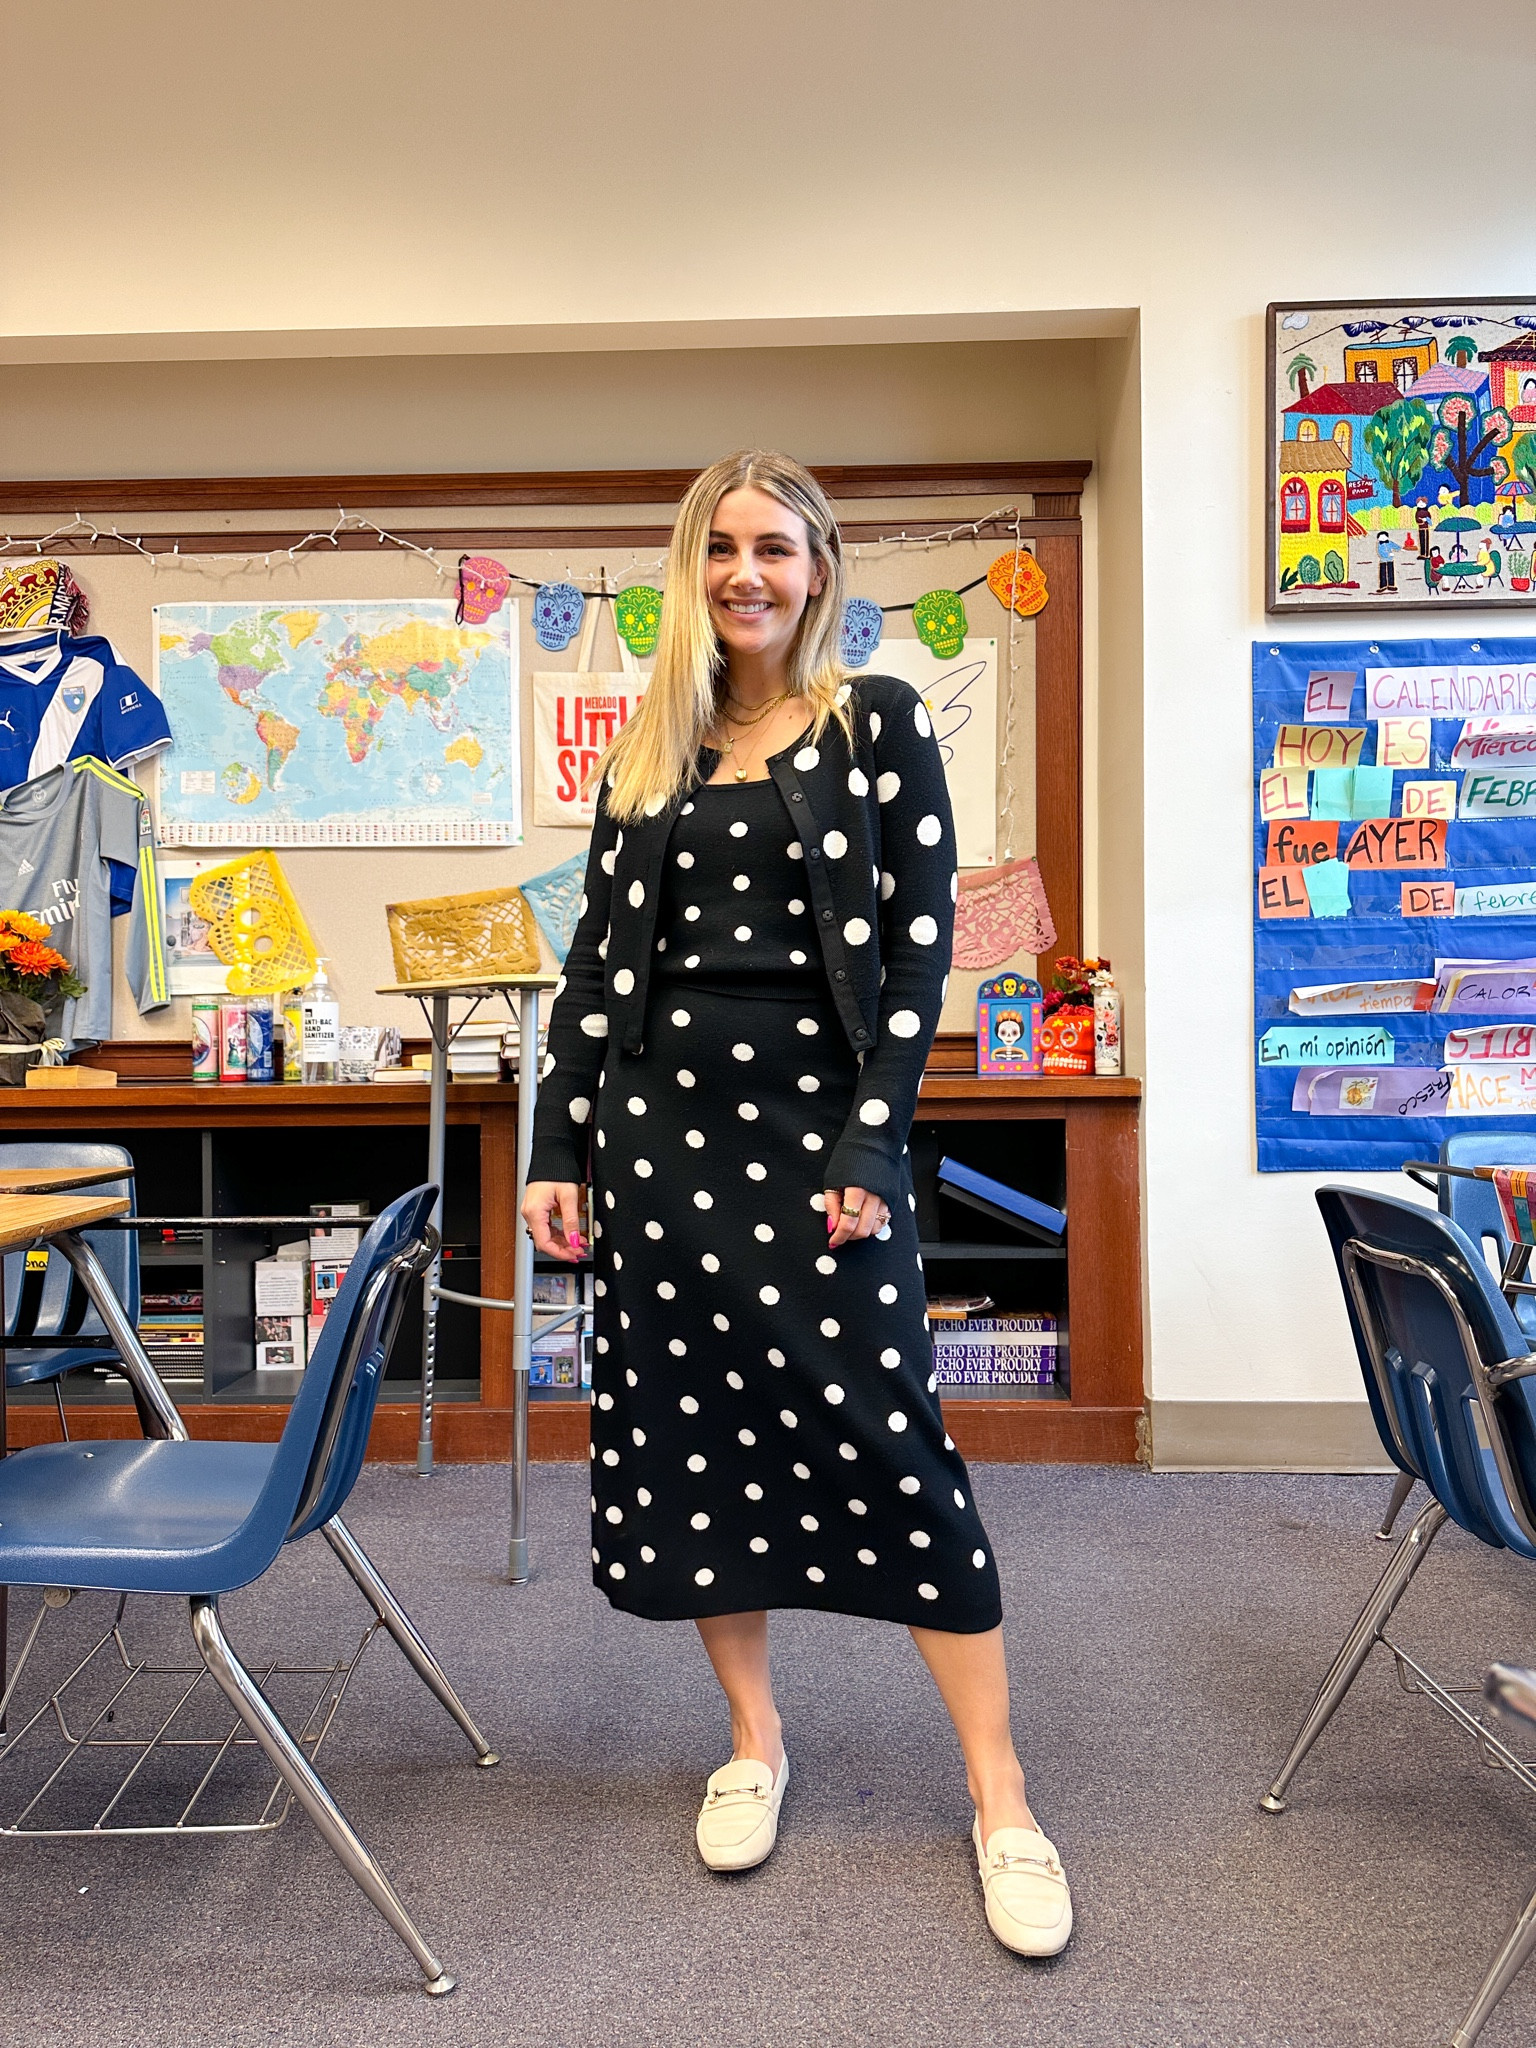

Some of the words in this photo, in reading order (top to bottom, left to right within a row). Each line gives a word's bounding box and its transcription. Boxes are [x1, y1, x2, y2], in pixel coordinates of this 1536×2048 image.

[585, 697, 617, 709] MERCADO
[1306, 677, 1347, 713] EL
[1280, 726, 1363, 766] HOY
[1384, 721, 1427, 766] ES
[1262, 773, 1304, 815] EL
[1406, 787, 1446, 813] DE
[1273, 825, 1330, 864] fue
[1347, 820, 1437, 864] AYER
[1262, 876, 1304, 908] EL
[1409, 887, 1451, 912] DE
[1359, 994, 1412, 1012] tiempo
[1458, 984, 1531, 1001] CALOR
[1260, 1038, 1290, 1062] En
[1300, 1035, 1318, 1058] mi
[1326, 1033, 1386, 1058] opinión
[1398, 1071, 1452, 1115] FRESCO
[938, 1319, 966, 1331] ECHO
[968, 1319, 994, 1331] EVER
[996, 1319, 1043, 1331] PROUDLY
[936, 1345, 965, 1357] ECHO
[967, 1345, 994, 1357] EVER
[994, 1345, 1042, 1357] PROUDLY
[935, 1358, 964, 1371] ECHO
[966, 1358, 994, 1371] EVER
[995, 1358, 1041, 1371] PROUDLY
[934, 1371, 962, 1384] ECHO
[964, 1371, 991, 1384] EVER
[992, 1371, 1039, 1384] PROUDLY
